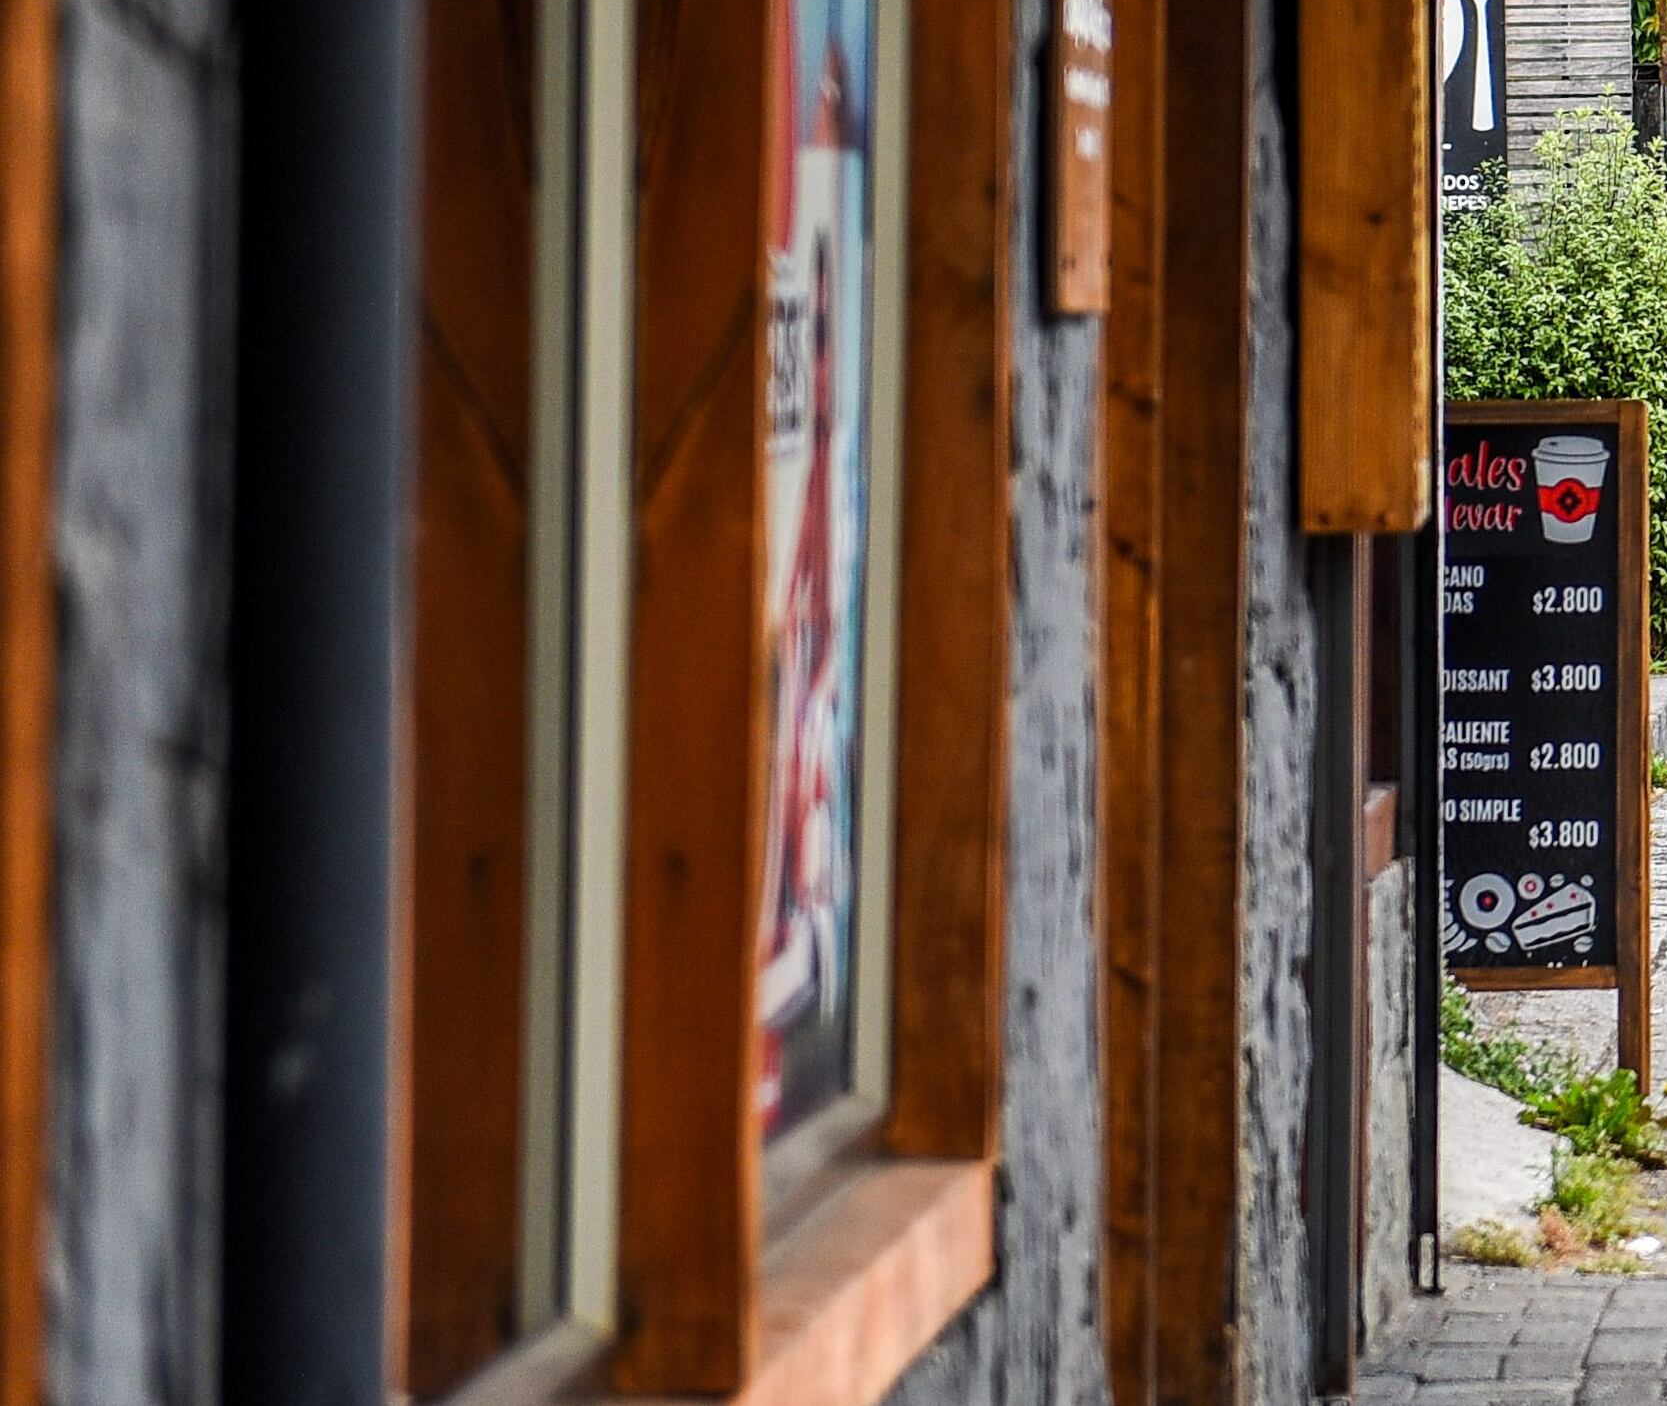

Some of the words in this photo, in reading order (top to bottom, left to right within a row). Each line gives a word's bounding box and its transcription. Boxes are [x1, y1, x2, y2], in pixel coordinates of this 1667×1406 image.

[1532, 586, 1603, 615] $2.800
[1531, 663, 1602, 692] $3.800
[1530, 742, 1600, 771] $2.800
[1459, 798, 1522, 822] SIMPLE
[1528, 820, 1599, 849] $3.800
